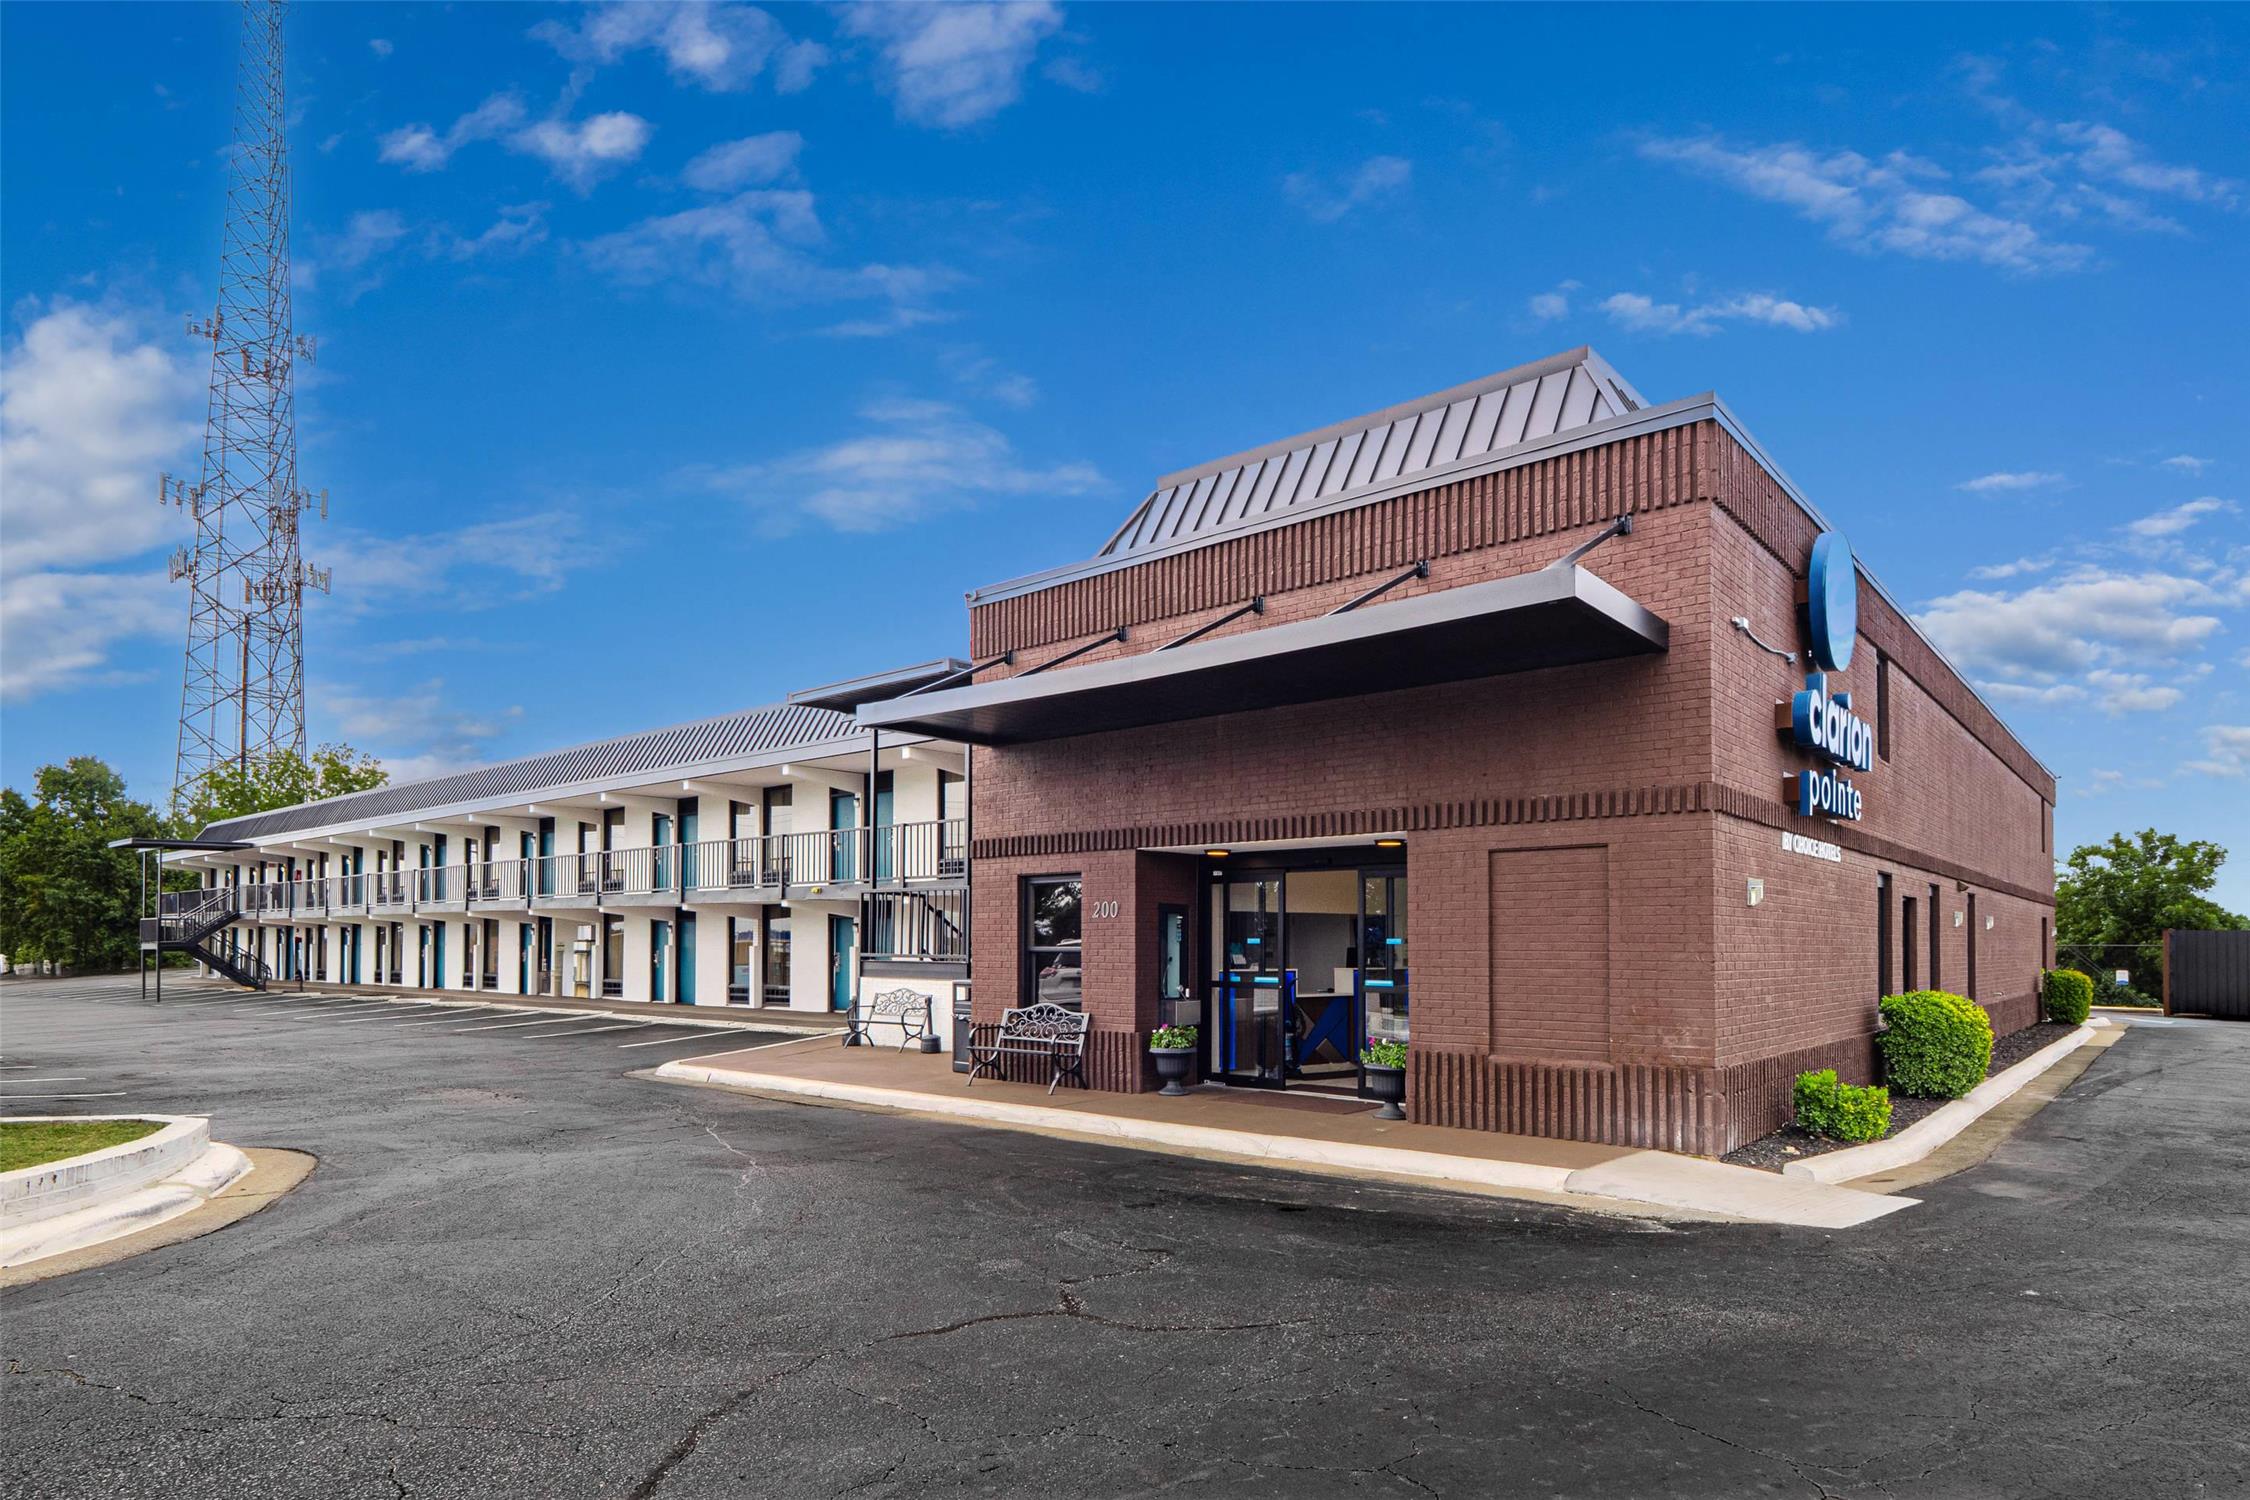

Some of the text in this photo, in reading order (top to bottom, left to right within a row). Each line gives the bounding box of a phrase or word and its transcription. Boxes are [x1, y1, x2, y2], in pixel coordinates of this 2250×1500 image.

[1809, 672, 1872, 772] clarion
[1809, 768, 1862, 821] pointe
[1793, 834, 1819, 858] CHOICE
[1092, 900, 1119, 918] 200
